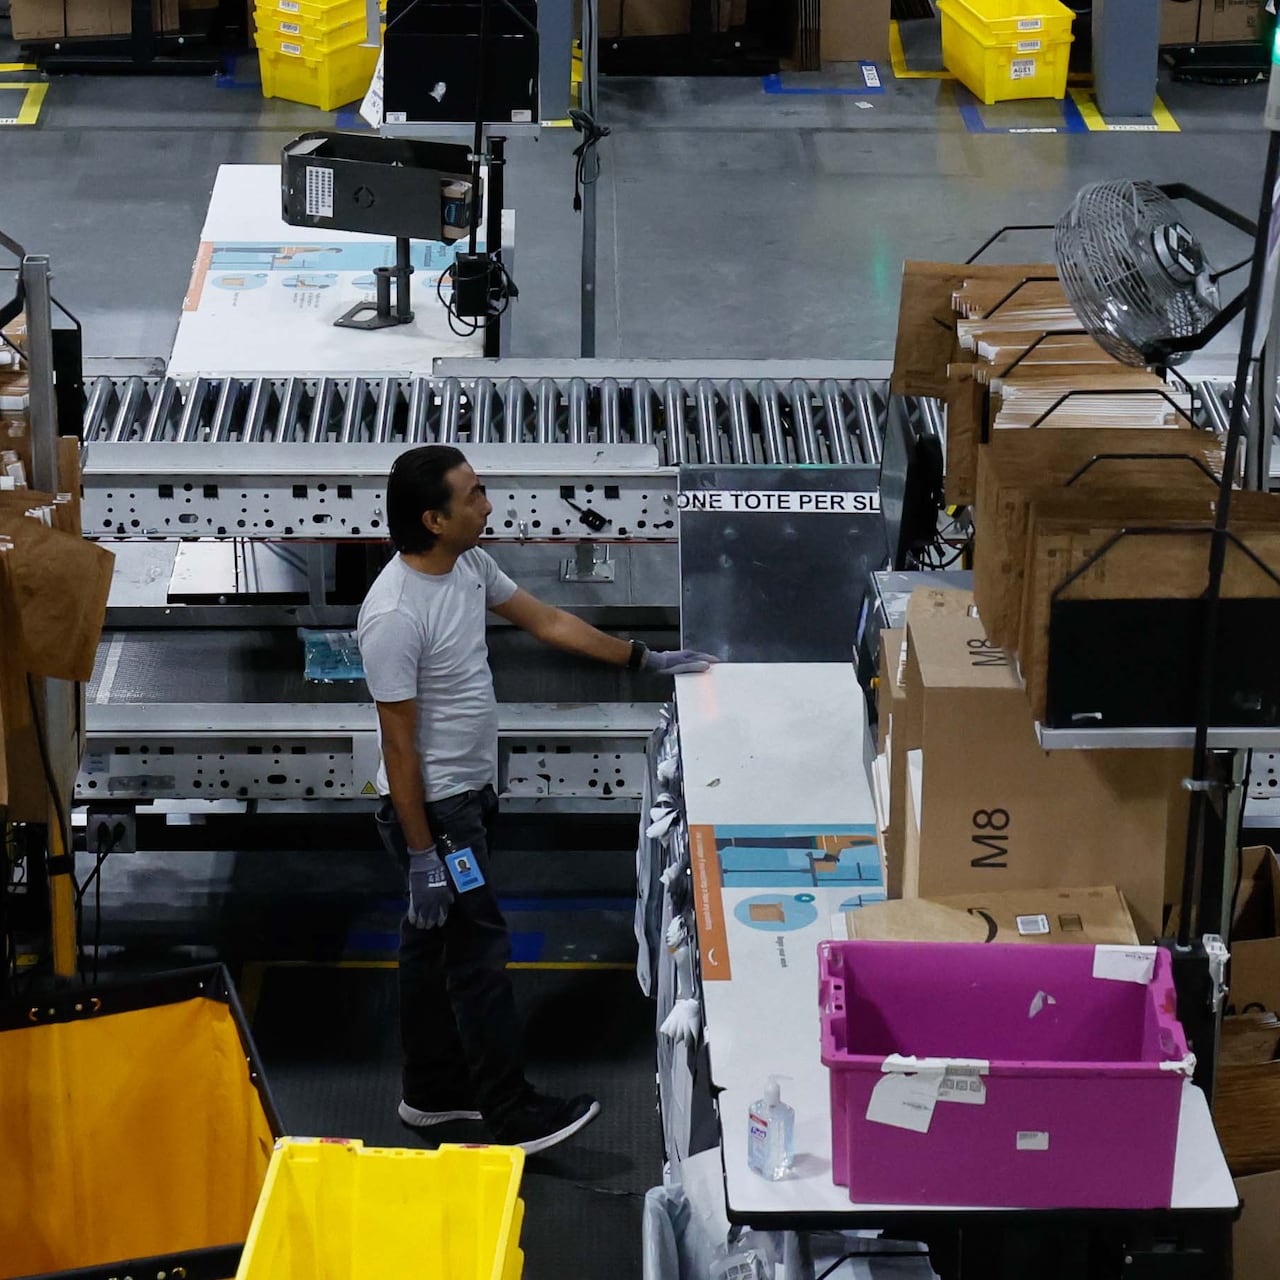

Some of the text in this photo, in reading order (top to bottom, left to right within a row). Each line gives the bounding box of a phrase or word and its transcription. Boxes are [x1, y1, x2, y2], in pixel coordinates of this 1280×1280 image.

[677, 492, 724, 510] ONE
[729, 492, 792, 510] TOTE
[798, 493, 845, 511] PER
[966, 638, 1009, 667] M8
[970, 807, 1010, 868] M8
